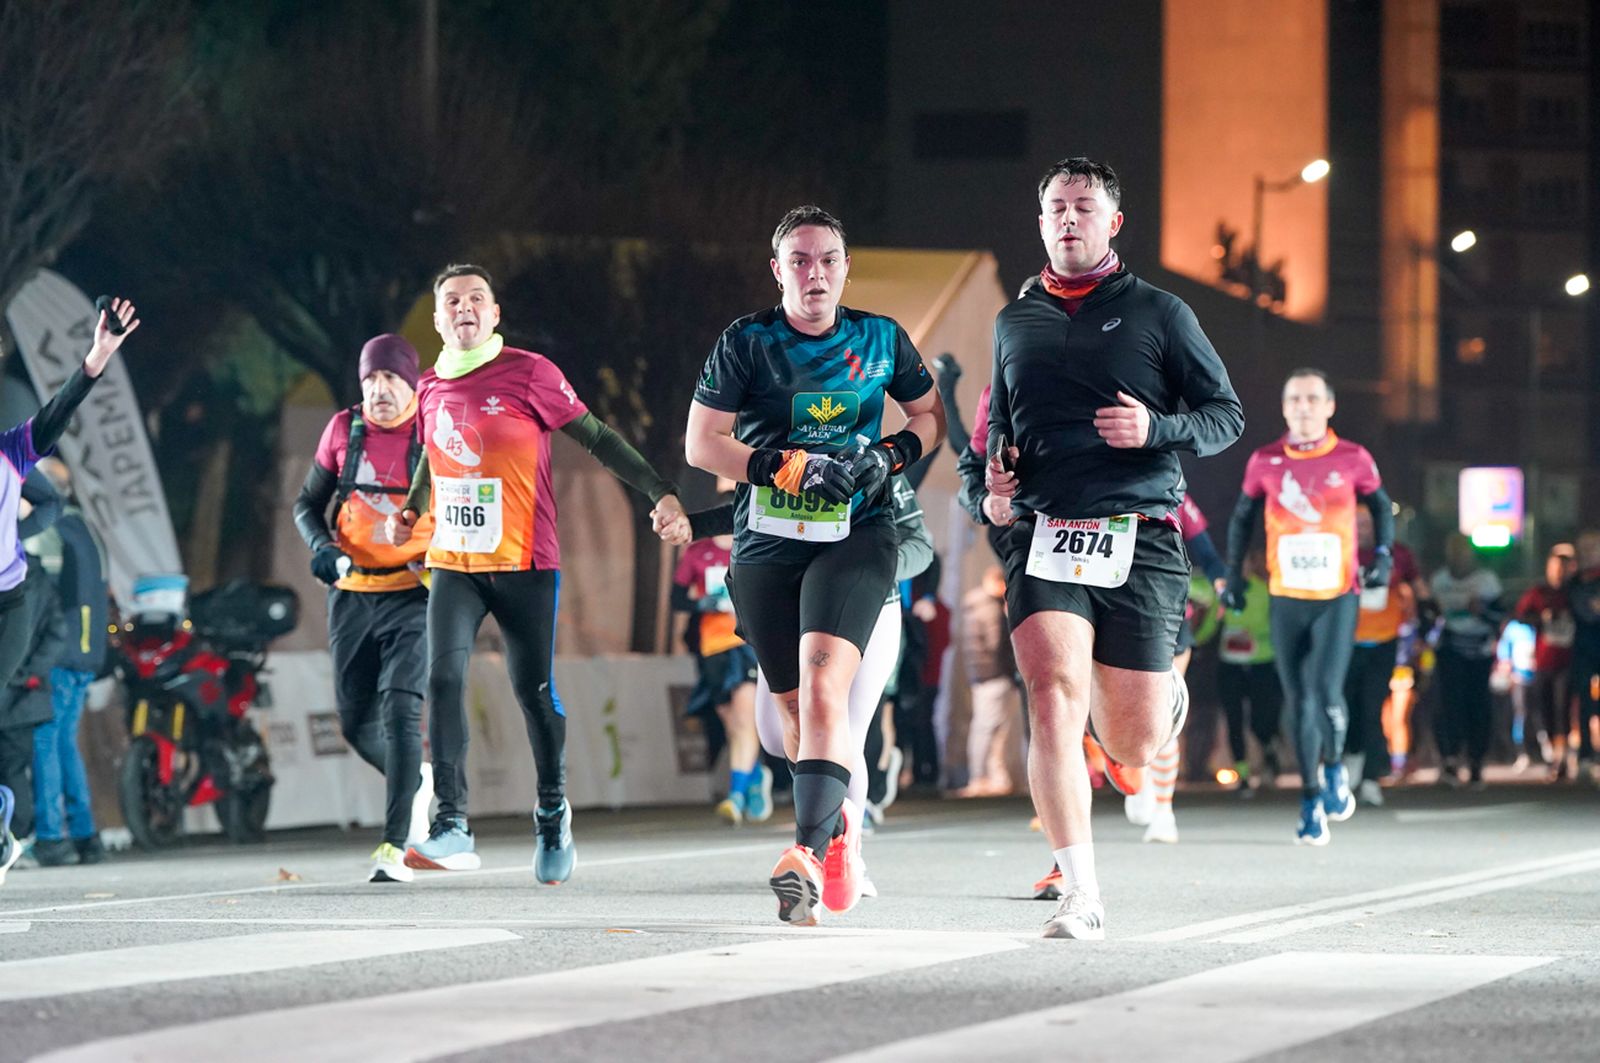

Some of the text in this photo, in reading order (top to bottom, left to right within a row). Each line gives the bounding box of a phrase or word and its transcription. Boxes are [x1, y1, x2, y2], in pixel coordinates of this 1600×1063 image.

[66, 315, 160, 518] JAPEMA
[445, 436, 463, 457] 43
[445, 504, 486, 528] 4766
[1047, 518, 1067, 528] SAN
[1068, 519, 1100, 530] ANTÓN
[1052, 529, 1114, 558] 2674
